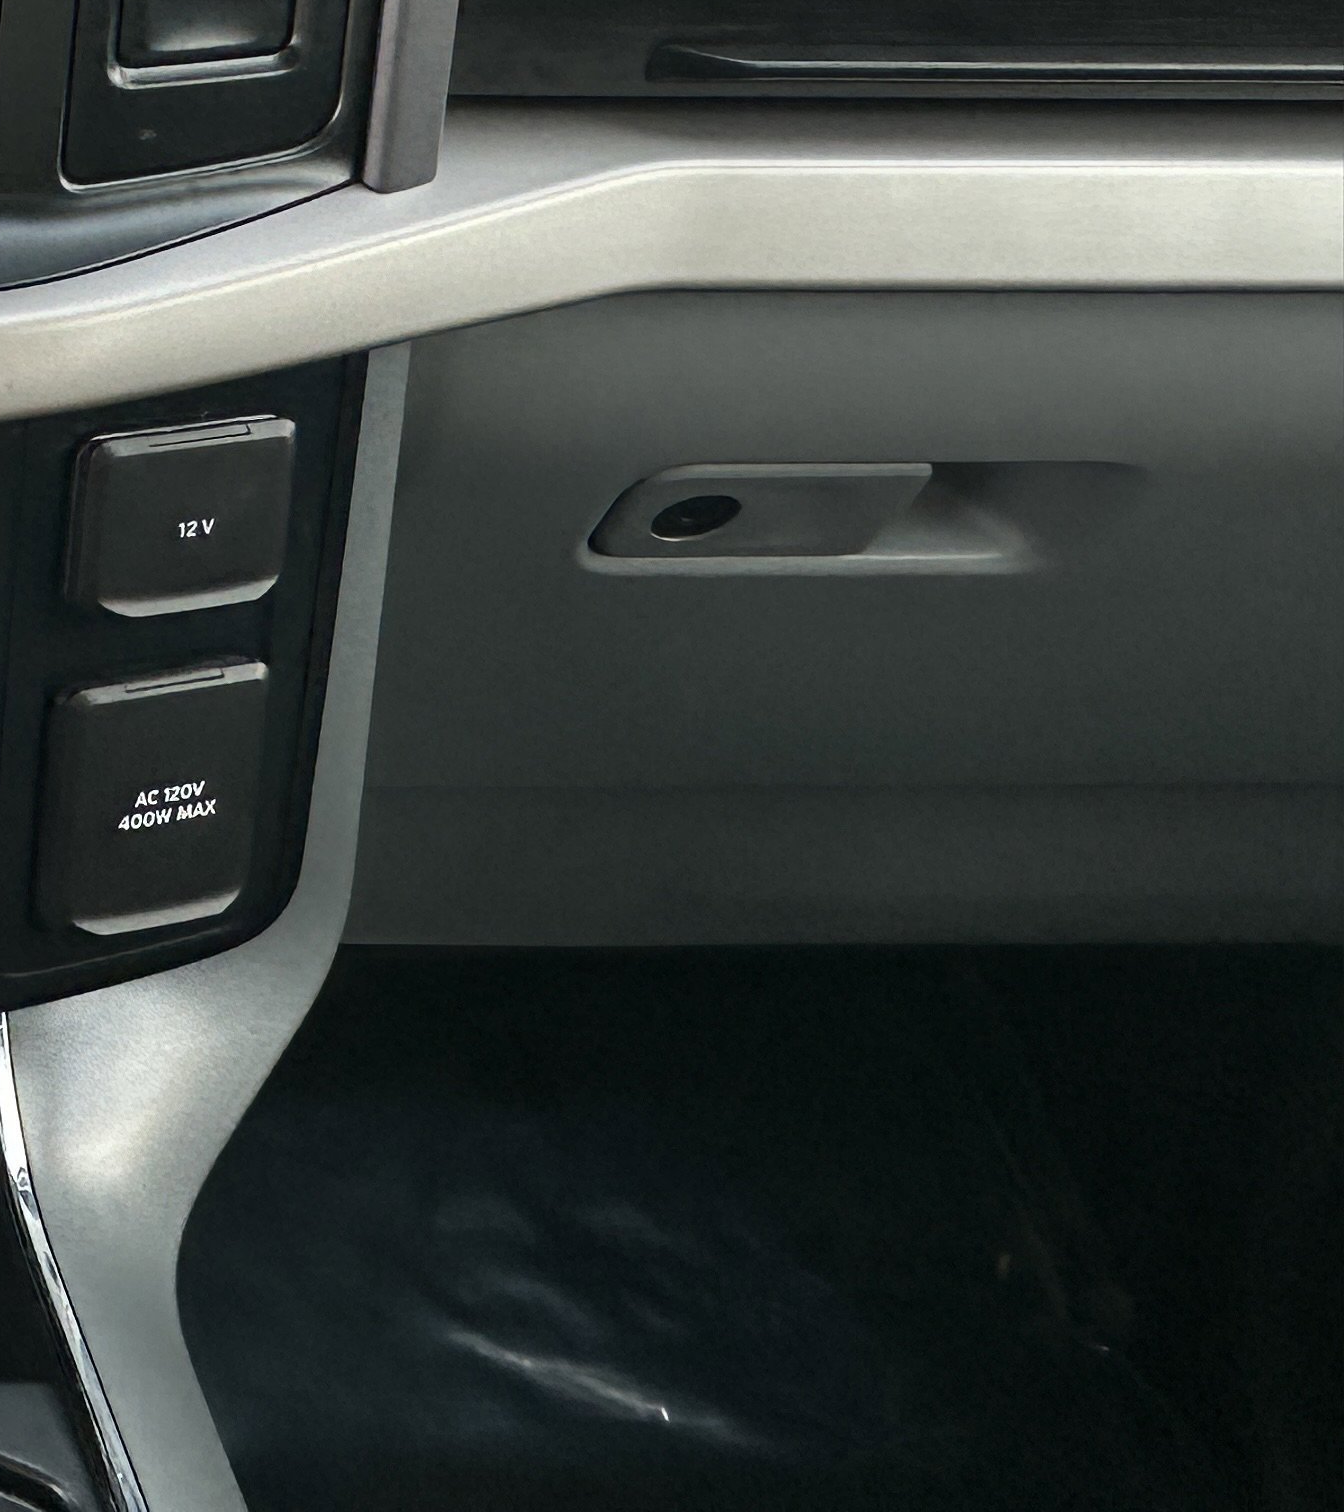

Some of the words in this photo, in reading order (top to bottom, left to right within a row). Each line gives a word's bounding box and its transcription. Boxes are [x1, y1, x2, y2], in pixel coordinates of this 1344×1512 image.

[178, 520, 198, 538] 12
[201, 518, 215, 535] V
[134, 788, 160, 809] AC
[163, 780, 206, 804] 120V
[117, 805, 172, 831] 400W
[176, 798, 217, 820] MAX
